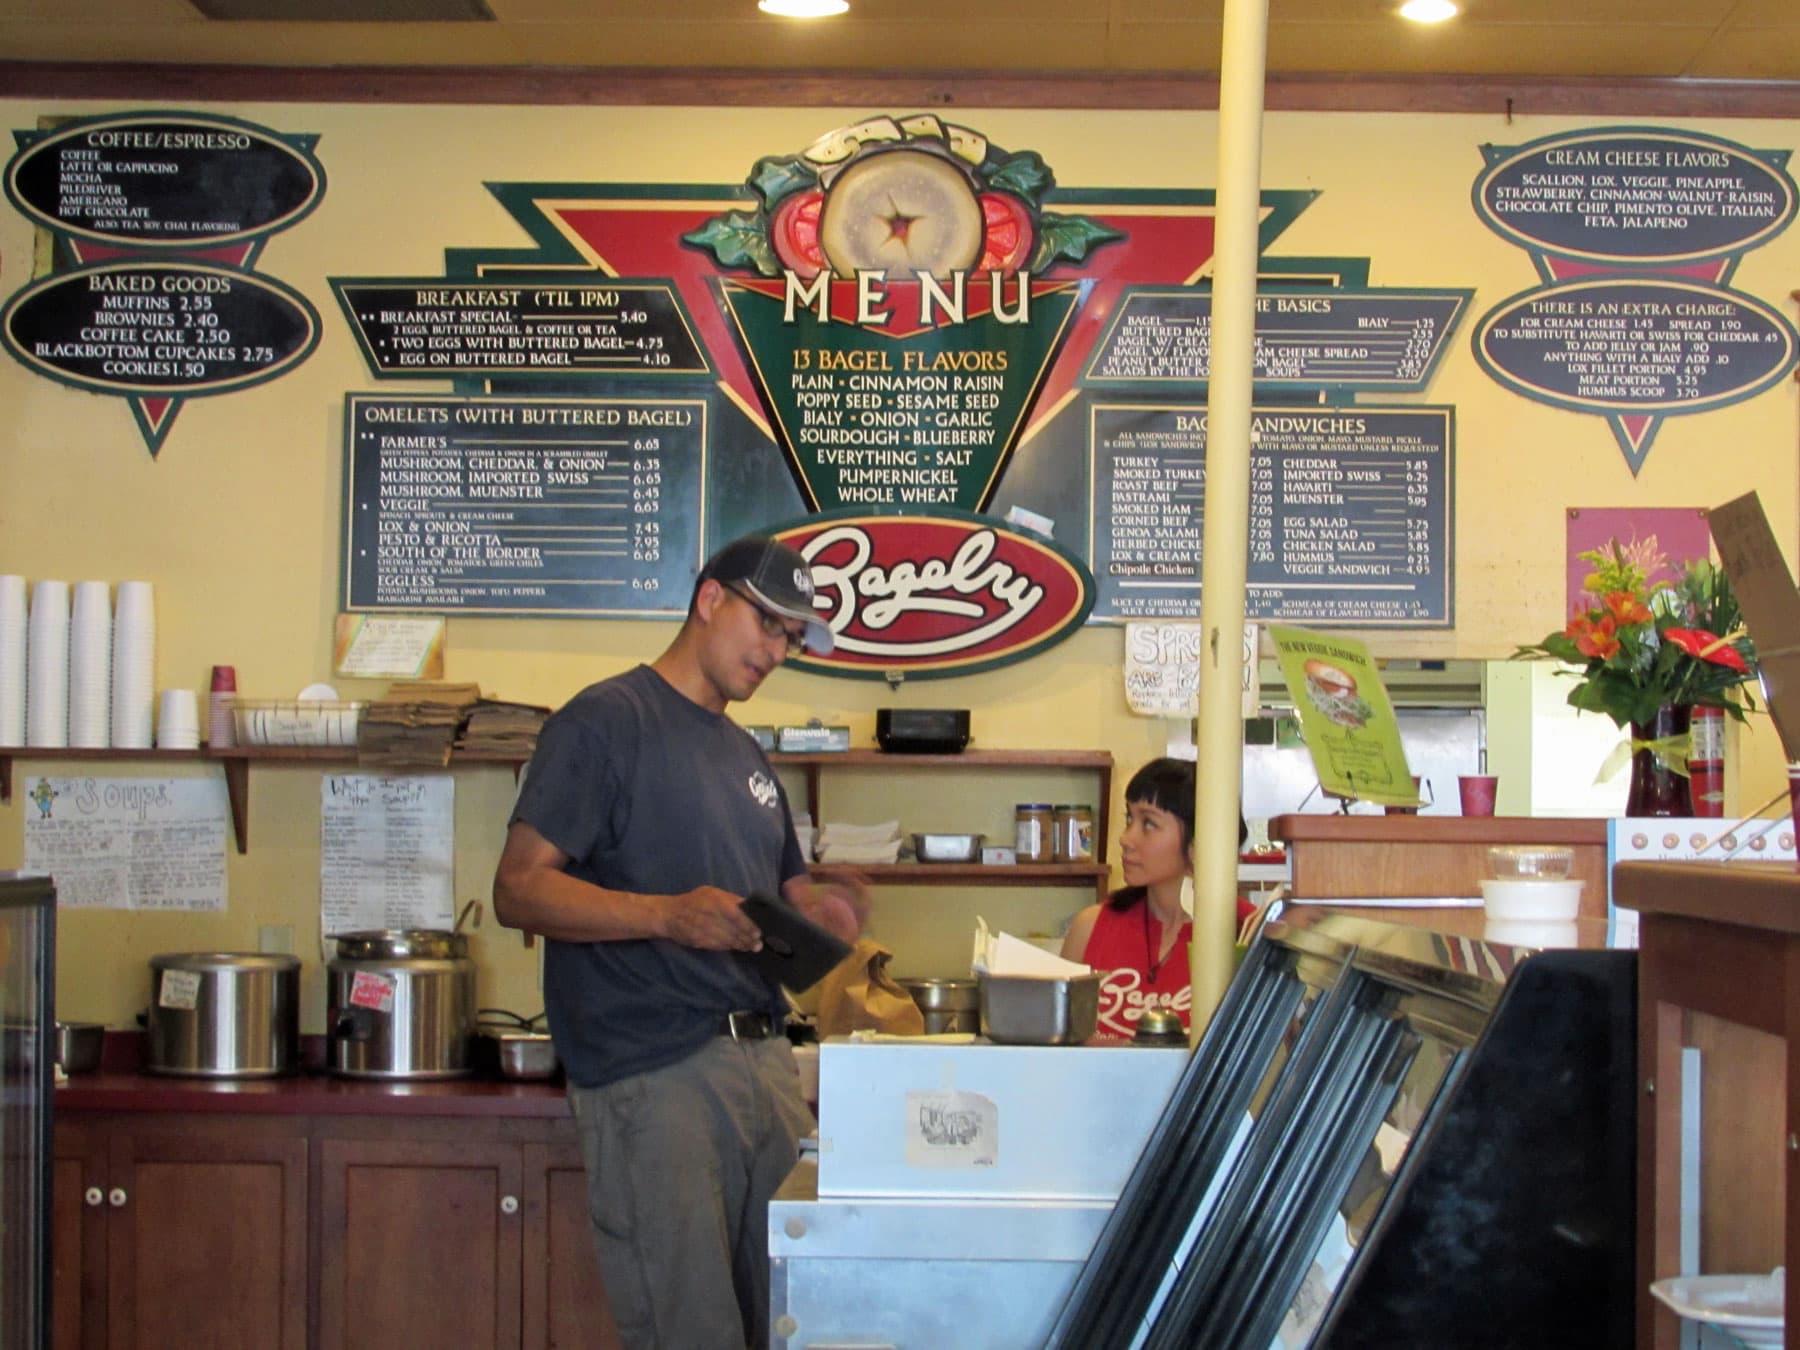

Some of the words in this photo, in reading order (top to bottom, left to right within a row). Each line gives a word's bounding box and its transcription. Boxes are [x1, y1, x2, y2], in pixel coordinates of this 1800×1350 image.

[88, 132, 250, 149] COFFEE/ESPRESSO
[61, 151, 100, 160] COFFEE
[1546, 151, 1600, 165] CREAM
[1606, 152, 1659, 166] CHEESE
[1666, 153, 1729, 167] FLAVORS
[61, 162, 92, 171] LATTE
[97, 162, 112, 172] OR
[116, 163, 178, 173] CAPPUCINO
[61, 173, 101, 182] MOCHA
[60, 184, 121, 194] PILEDRIVER
[61, 196, 127, 206] AMERICANO
[60, 206, 80, 215] HOT
[85, 206, 148, 217] CHOCOLATE
[1496, 201, 1572, 212] CHOCOLATE
[1616, 203, 1672, 214] PIMENTO
[1624, 217, 1687, 228] JALAPENO
[88, 276, 155, 291] BAKED
[162, 277, 231, 292] GOODS
[417, 291, 520, 306] BREAKFAST
[784, 269, 1031, 323] MENU
[104, 296, 169, 309] MUFFINS
[181, 296, 212, 310] 2.55
[1278, 299, 1330, 312] BASICS
[1531, 302, 1574, 314] THERE
[1581, 303, 1592, 314] IS
[1598, 304, 1618, 314] AN
[1624, 304, 1671, 315] EXTRA
[96, 312, 174, 326] BROWNIES
[185, 314, 218, 327] 2.40
[381, 312, 455, 323] BREAKFAST
[620, 312, 647, 322] 5.40
[1128, 316, 1161, 325] BAGEL
[1358, 318, 1388, 327] BIALY
[431, 325, 477, 334] BUTTERED
[537, 325, 575, 334] COFFEE
[578, 325, 591, 334] OR
[596, 325, 616, 334] TEA
[1123, 326, 1181, 336] BUTTERED
[81, 328, 138, 342] COFFEE
[142, 330, 184, 343] CAKE
[197, 330, 230, 344] 2.50
[392, 338, 424, 348] TWO
[429, 337, 461, 348] EGGS
[466, 337, 502, 348] WITH
[509, 337, 579, 348] BUTTERED
[584, 338, 624, 348] BAGEL
[636, 337, 663, 349] 4.75
[36, 344, 149, 358] BLACKBOTTOM
[155, 346, 235, 360] CUPCAKES
[244, 347, 273, 362] 2.75
[400, 354, 425, 364] EGG
[430, 354, 449, 364] ON
[456, 353, 525, 364] BUTTERED
[531, 353, 570, 364] BAGEL
[642, 354, 670, 365] 4.10
[1544, 352, 1602, 362] ANYTHING
[1606, 353, 1636, 362] WITH
[1640, 354, 1648, 362] A
[1653, 354, 1681, 363] BIALY
[1686, 354, 1709, 363] ADD
[794, 350, 810, 369] 13
[819, 350, 892, 370] BAGEL
[904, 352, 1007, 371] FLAVORS
[1109, 357, 1154, 366] PEANUT
[1159, 357, 1202, 366] BUTTER
[792, 374, 833, 389] PLAIN
[850, 376, 947, 391] CINNAMON
[954, 376, 1003, 390] RAISIN
[1578, 386, 1626, 396] HUMMUS
[1630, 387, 1665, 396] SCOOP
[797, 392, 840, 408] POPPY
[846, 394, 882, 408] SEED
[897, 394, 958, 409] SESAME
[966, 394, 999, 408] SEED
[366, 408, 448, 423] OMELETS
[456, 409, 513, 424] (WITH
[523, 409, 620, 424] BUTTERED
[628, 411, 691, 425] BAGEL)
[804, 412, 842, 425] BIALY
[861, 412, 918, 427] ONION
[936, 412, 992, 427] GARLIC
[1251, 418, 1365, 433] ANDWICHES
[380, 437, 446, 448] FARMER'S
[800, 428, 899, 444] SOURDOUGH
[914, 430, 994, 445] BLUEBERRY
[818, 449, 917, 465] EVERYTHING
[936, 451, 972, 465] SALT
[1114, 457, 1158, 467] TURKEY
[544, 458, 553, 469] &
[560, 459, 604, 470] ONION
[469, 472, 540, 484] IMPORTED
[548, 473, 588, 484] SWISS
[840, 469, 957, 484] PUMPERNICKEL
[1114, 470, 1160, 478] SMOKED
[1113, 481, 1148, 490] ROAST
[1153, 481, 1177, 490] BEEF
[470, 486, 542, 498] MUENSTER
[838, 487, 894, 502] WHOLE
[901, 488, 958, 502] WHEAT
[1113, 492, 1169, 502] PASTRAMI
[1284, 494, 1343, 504] MUENSTER
[1112, 504, 1158, 514] SMOKED
[1163, 504, 1190, 514] HAM
[1112, 516, 1158, 526] CORNED
[1163, 516, 1189, 526] BEEF
[1112, 528, 1150, 537] GENOA
[1155, 528, 1198, 538] SALAMI
[1112, 551, 1131, 560] LOX
[1136, 551, 1144, 560] &
[1149, 551, 1190, 560] CREAM
[1284, 552, 1334, 562] HUMMUS
[1110, 563, 1150, 576] Chipotle
[1154, 564, 1194, 574] Chicken
[800, 527, 1043, 657] Bagelry
